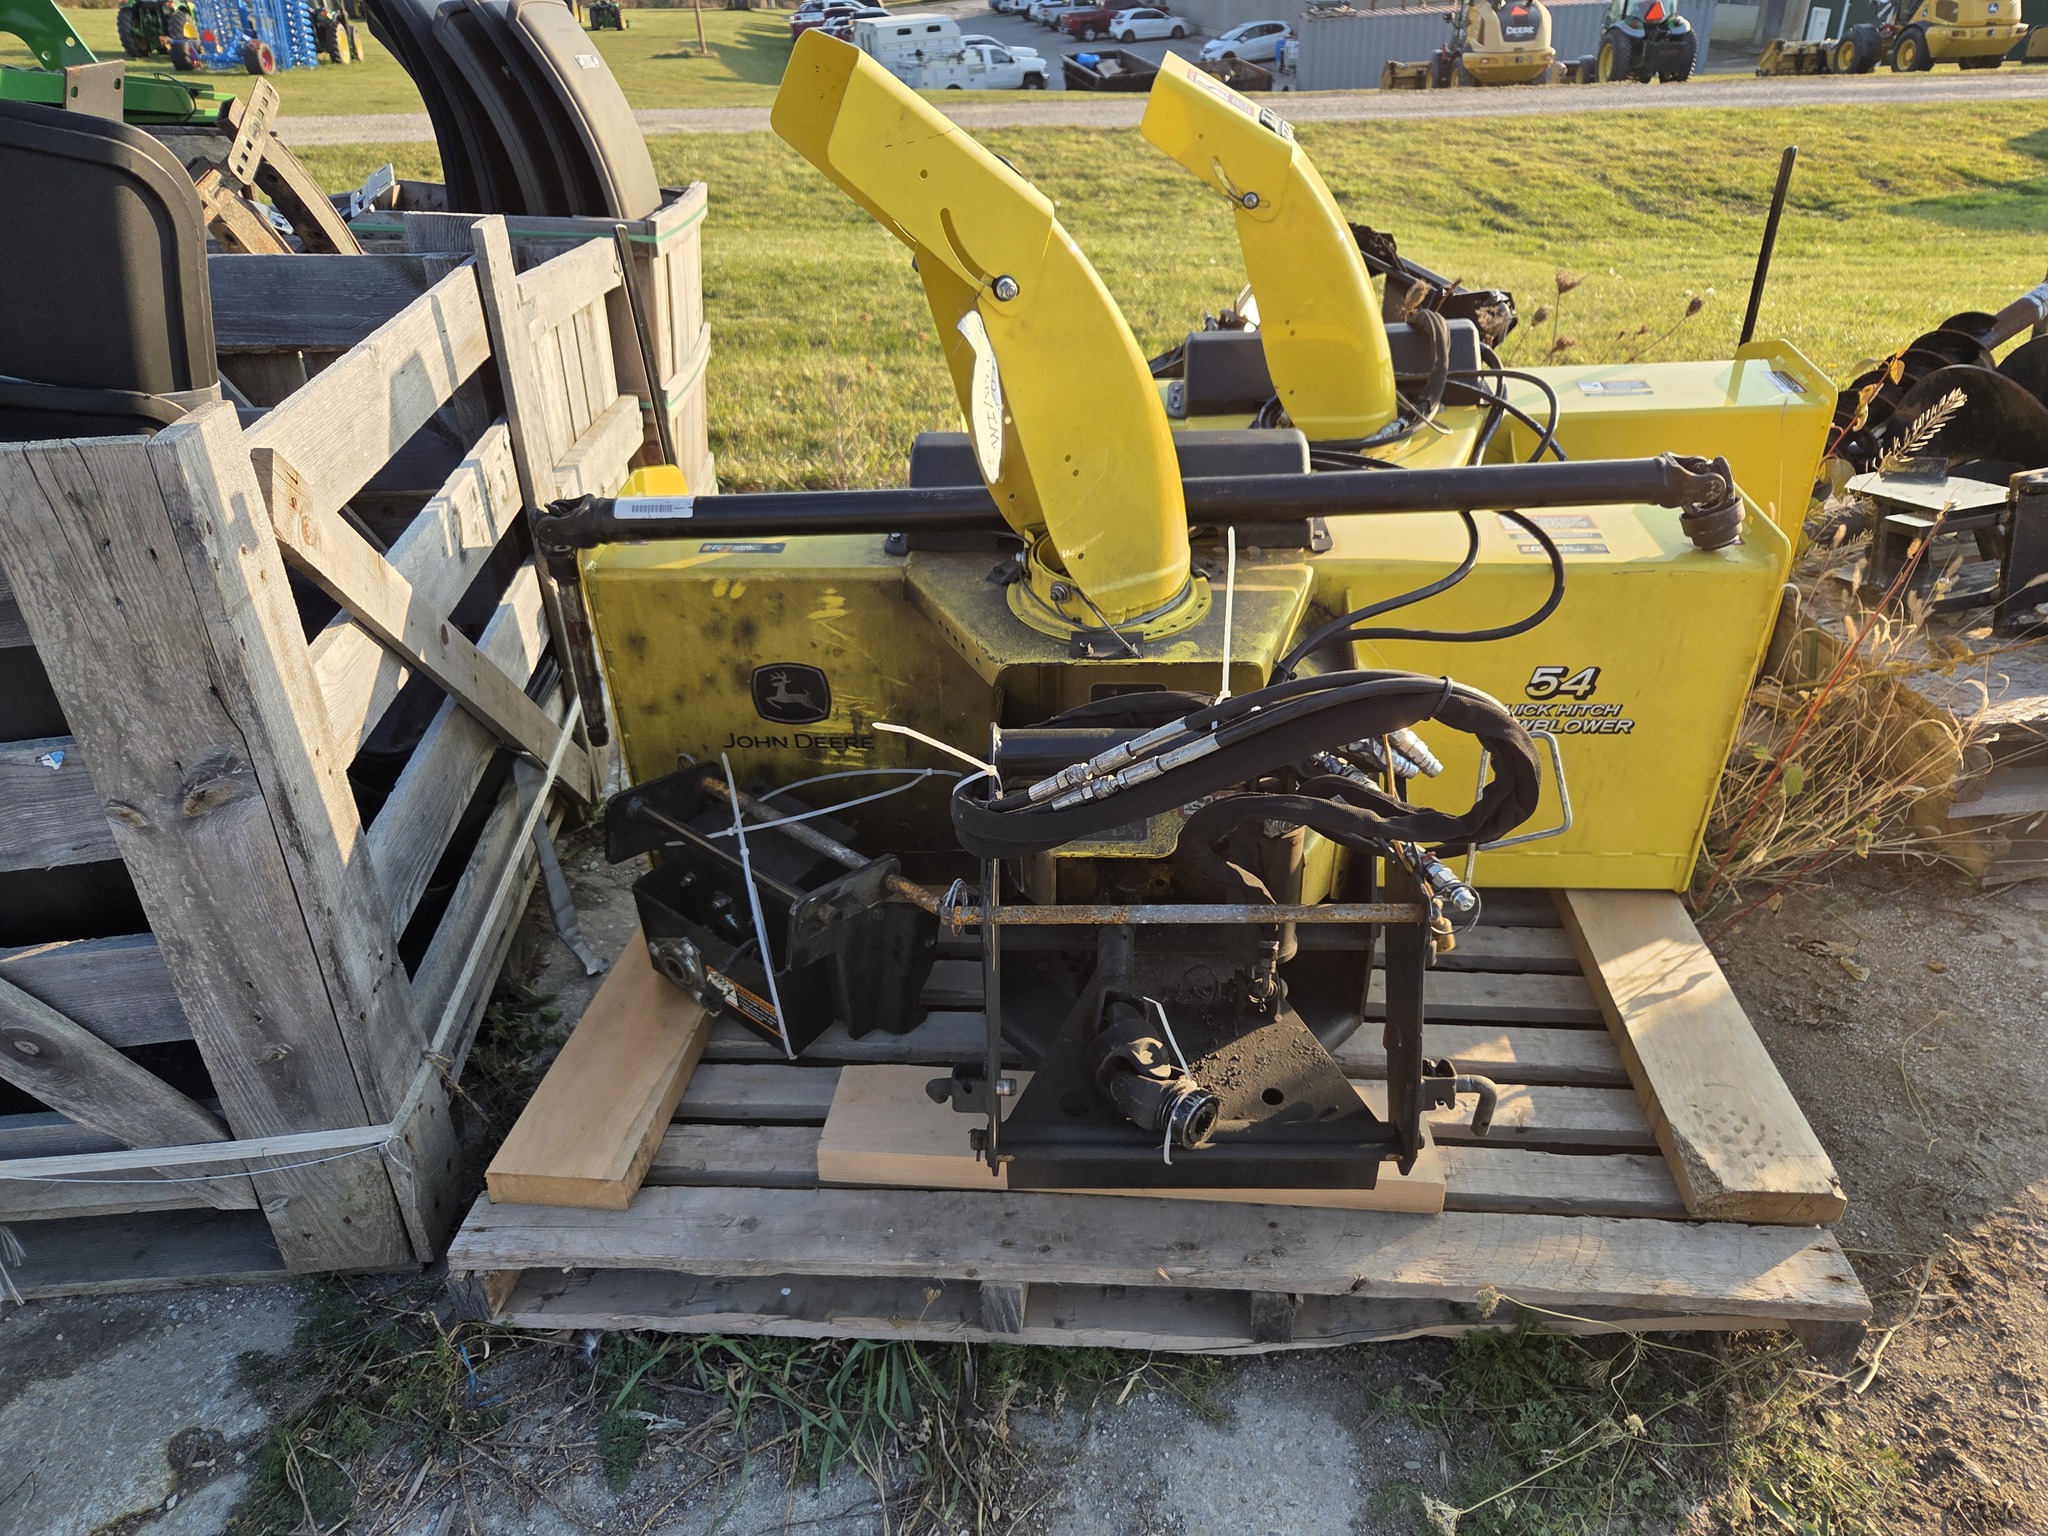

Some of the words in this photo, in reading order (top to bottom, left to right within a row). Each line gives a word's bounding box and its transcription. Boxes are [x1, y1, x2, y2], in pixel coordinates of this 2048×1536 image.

[1525, 666, 1601, 701] 54
[1505, 703, 1558, 718] UICK
[1553, 703, 1624, 718] HITCH
[1516, 718, 1636, 734] WBLOWER
[723, 732, 789, 750] JOHN
[794, 733, 876, 750] DEERE
